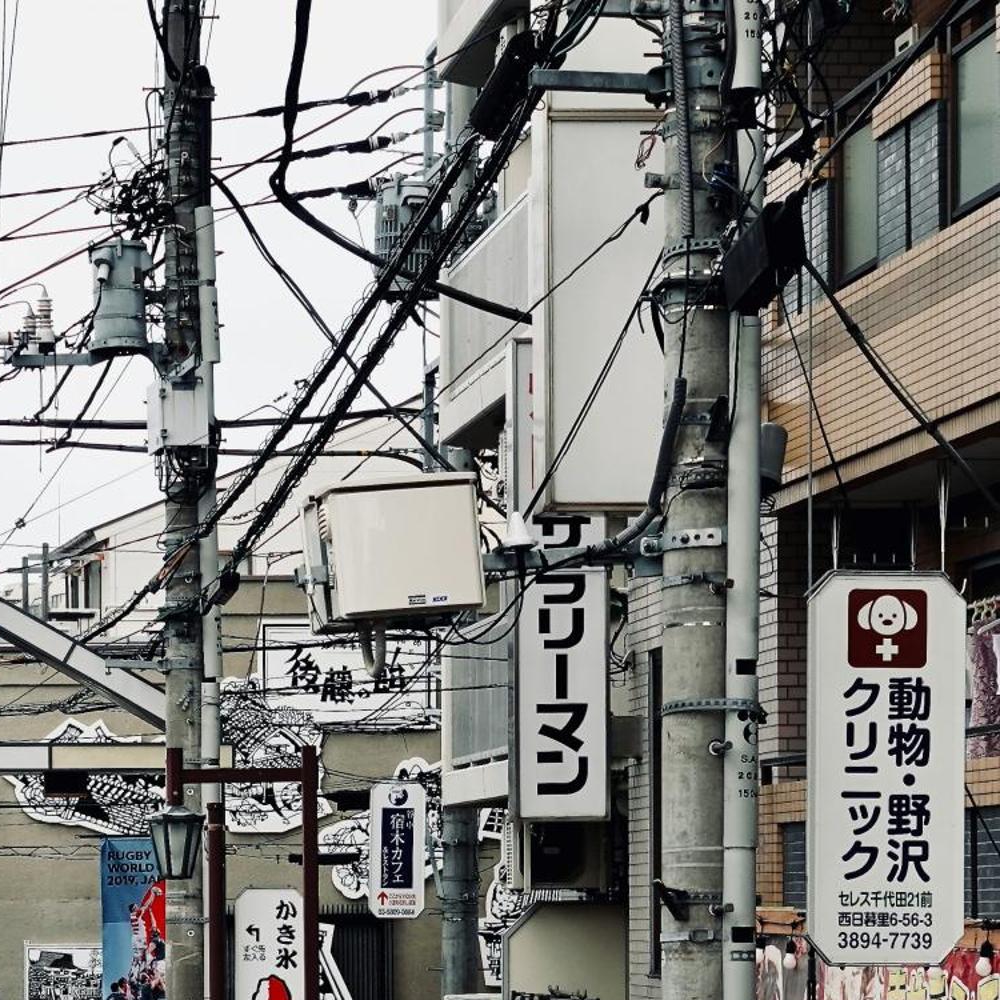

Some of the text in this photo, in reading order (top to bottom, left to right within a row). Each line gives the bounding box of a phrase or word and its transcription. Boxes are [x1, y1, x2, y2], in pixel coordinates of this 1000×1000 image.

[841, 677, 891, 882] クリニック
[887, 677, 931, 883] 動物・野沢
[107, 850, 153, 861] RUGBY
[107, 862, 154, 874] WORLD
[838, 891, 934, 908] セレス千代田21前
[838, 912, 934, 928] 西日暮里6-56-3
[275, 900, 298, 970] かき氷
[838, 932, 934, 950] 3894-7739
